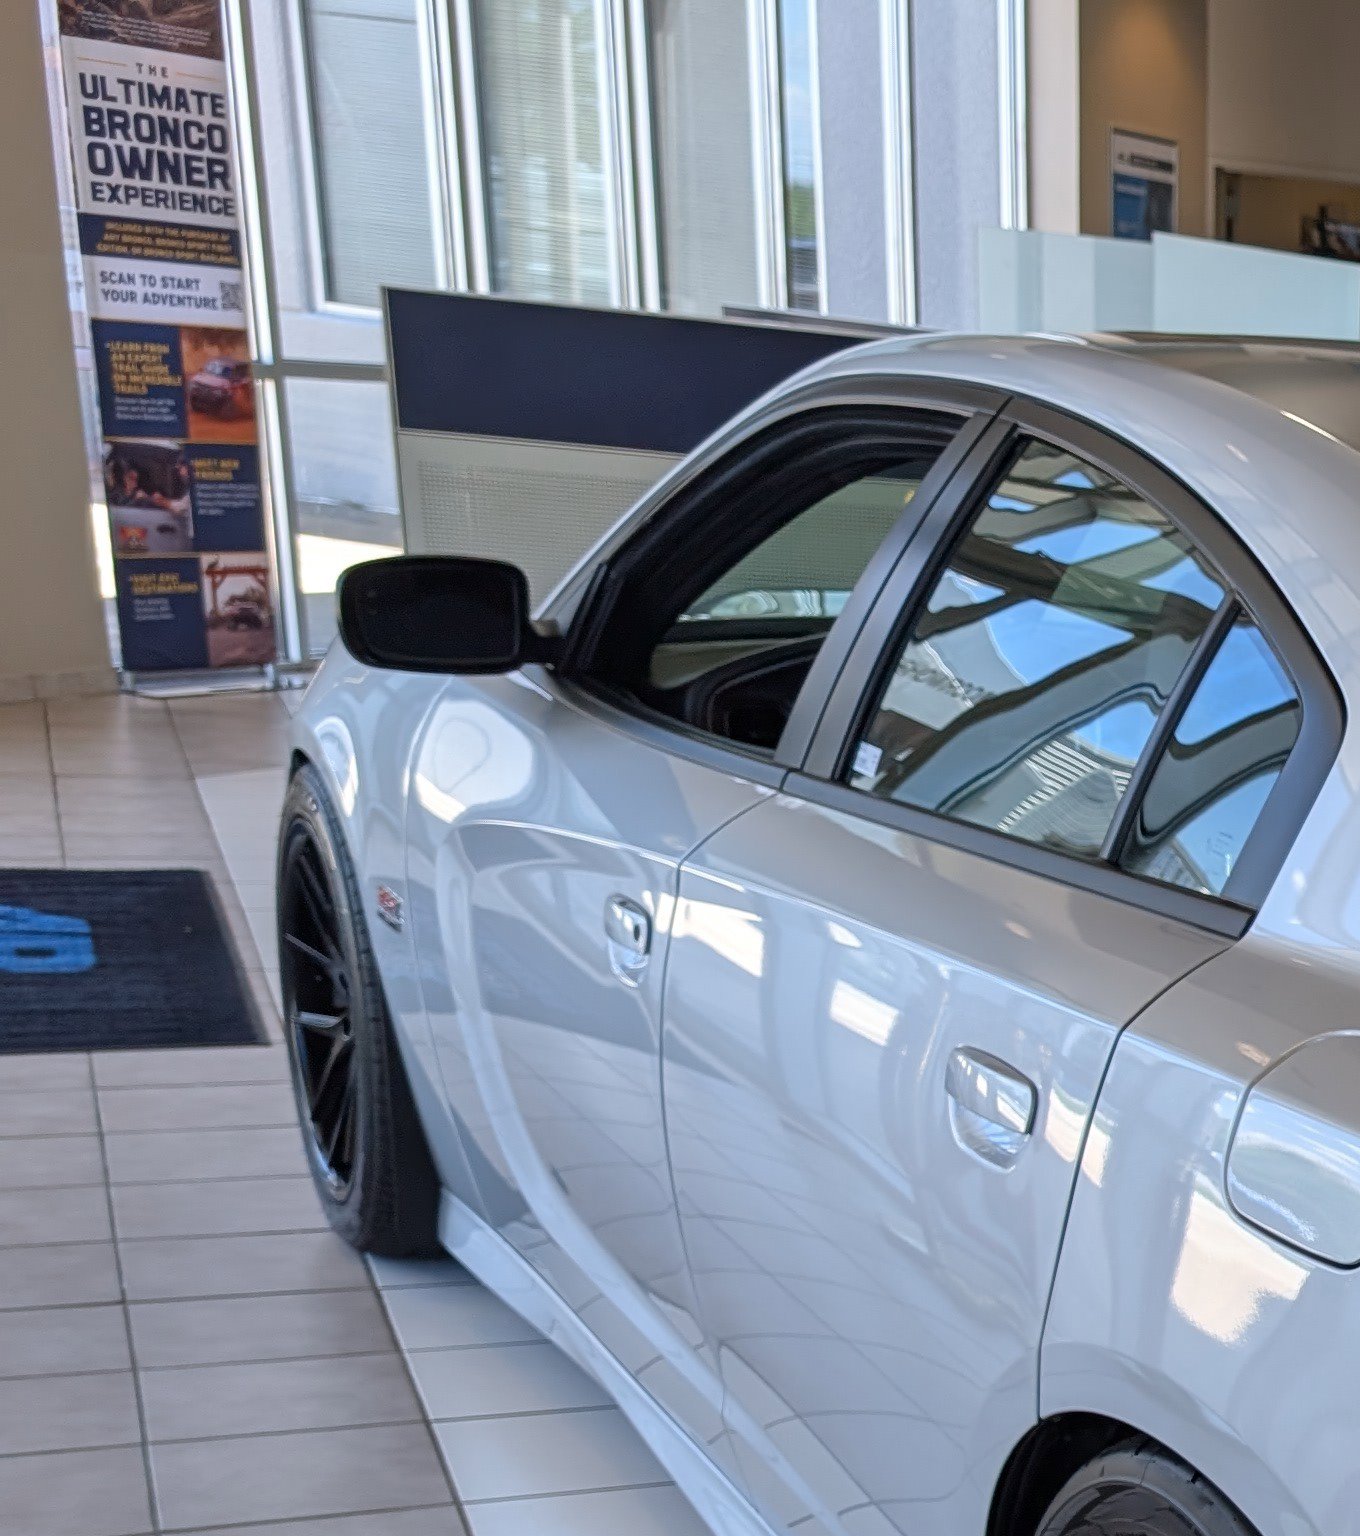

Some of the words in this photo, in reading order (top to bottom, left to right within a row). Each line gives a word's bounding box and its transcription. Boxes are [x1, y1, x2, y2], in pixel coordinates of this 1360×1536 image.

[135, 62, 169, 78] THE
[79, 72, 225, 118] ULTIMATE
[83, 105, 229, 153] BRONCO
[87, 141, 231, 191] OWNER
[91, 181, 236, 217] EXPERIENCE
[100, 270, 137, 286] SCAN
[140, 274, 157, 288] TO
[160, 275, 201, 290] START
[101, 288, 138, 303] YOUR
[143, 291, 217, 309] ADVENTURE
